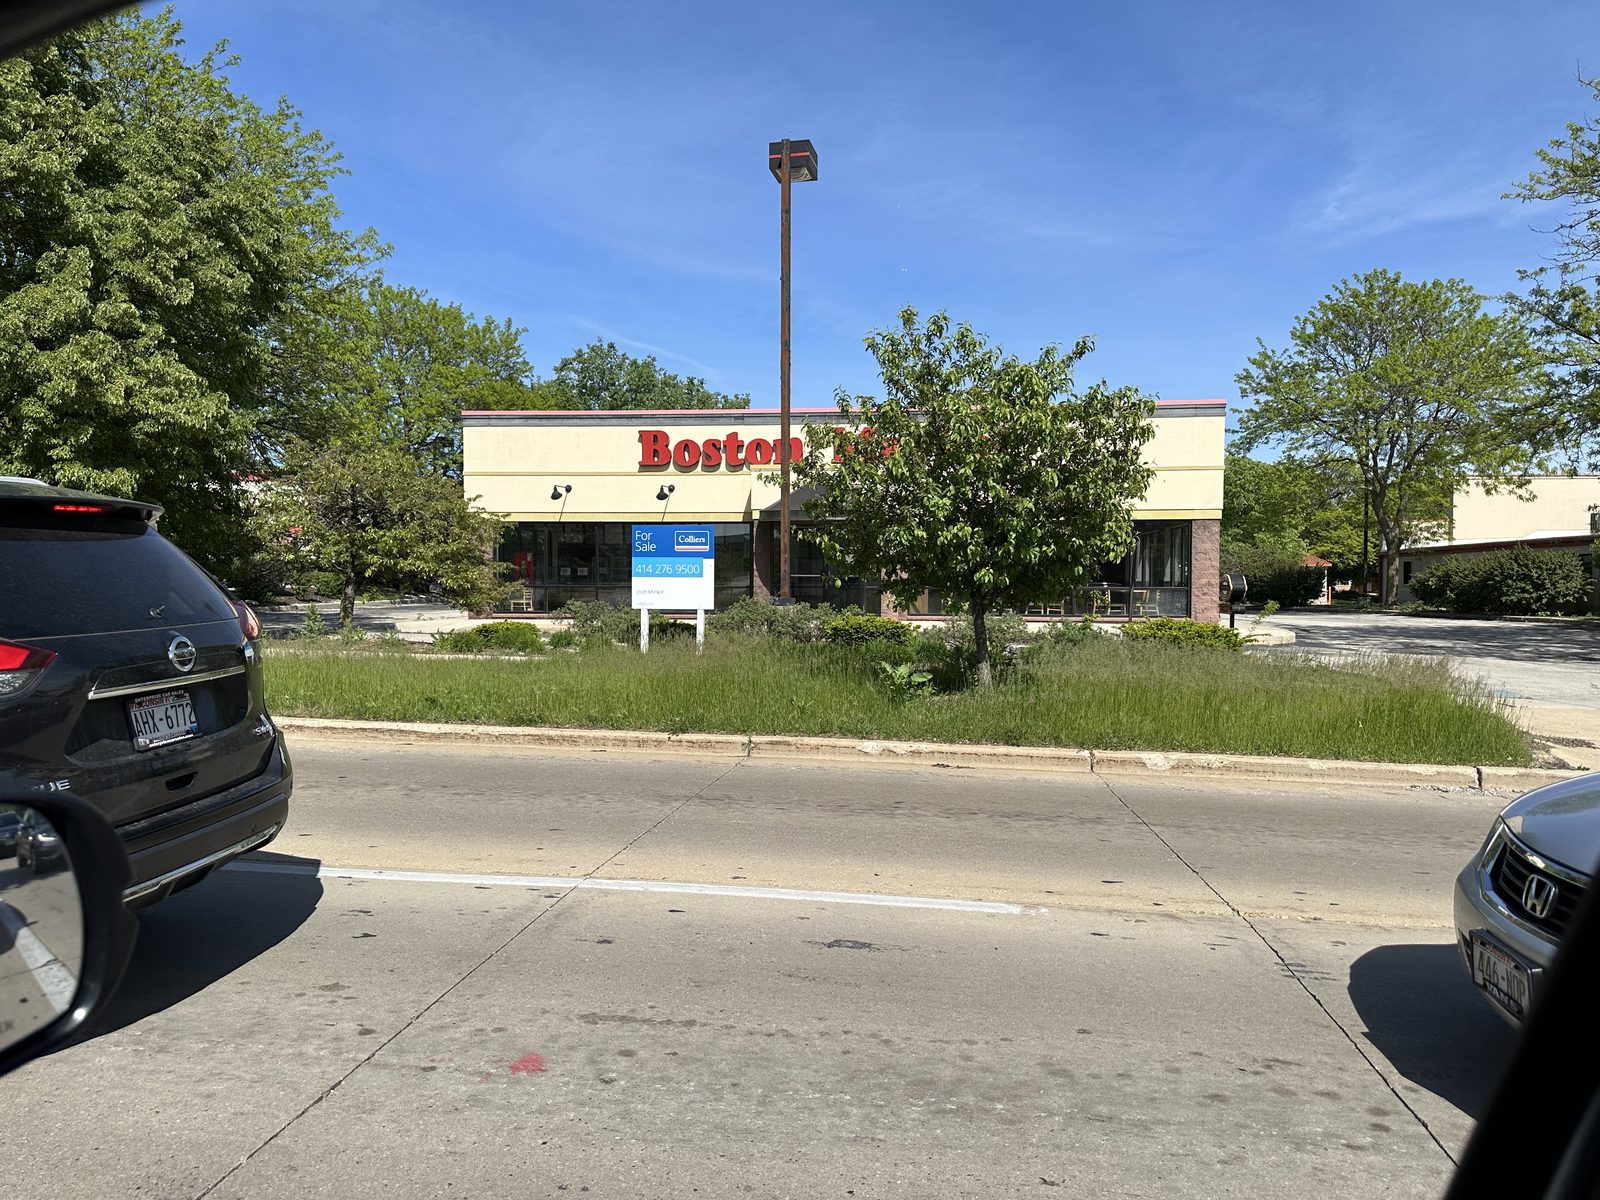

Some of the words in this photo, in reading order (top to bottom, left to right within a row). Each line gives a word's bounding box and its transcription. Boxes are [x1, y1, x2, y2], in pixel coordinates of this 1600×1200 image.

[638, 429, 803, 466] Boston
[635, 530, 653, 541] For
[678, 534, 706, 543] Colliers
[635, 541, 657, 552] Sale
[635, 564, 653, 574] 414
[655, 564, 673, 574] 276
[675, 564, 700, 574] 9500
[133, 702, 197, 737] AHX-6772
